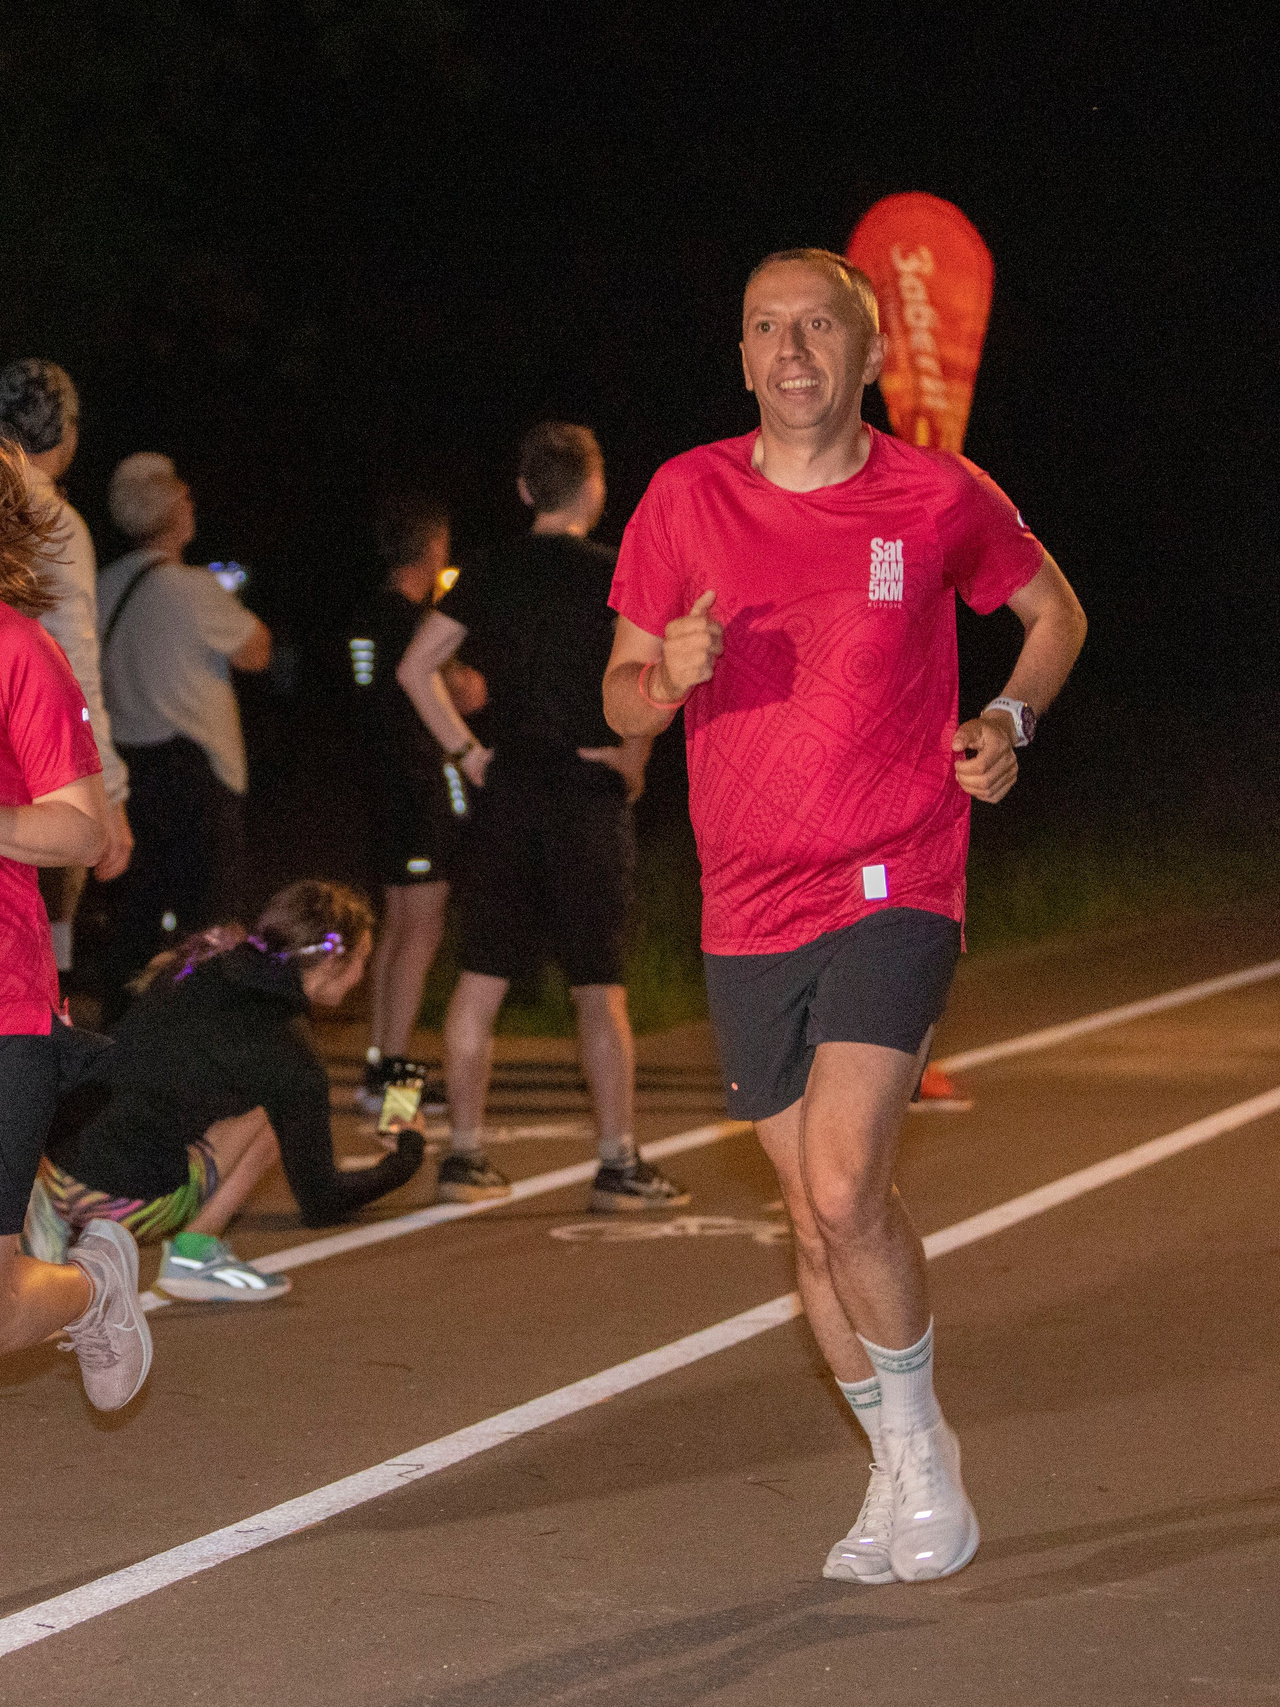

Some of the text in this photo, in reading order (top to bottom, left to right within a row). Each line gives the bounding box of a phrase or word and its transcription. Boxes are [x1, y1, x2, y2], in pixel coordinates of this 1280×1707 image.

[870, 537, 903, 562] Sat
[869, 561, 903, 581] 9AM
[868, 580, 903, 601] 5KM
